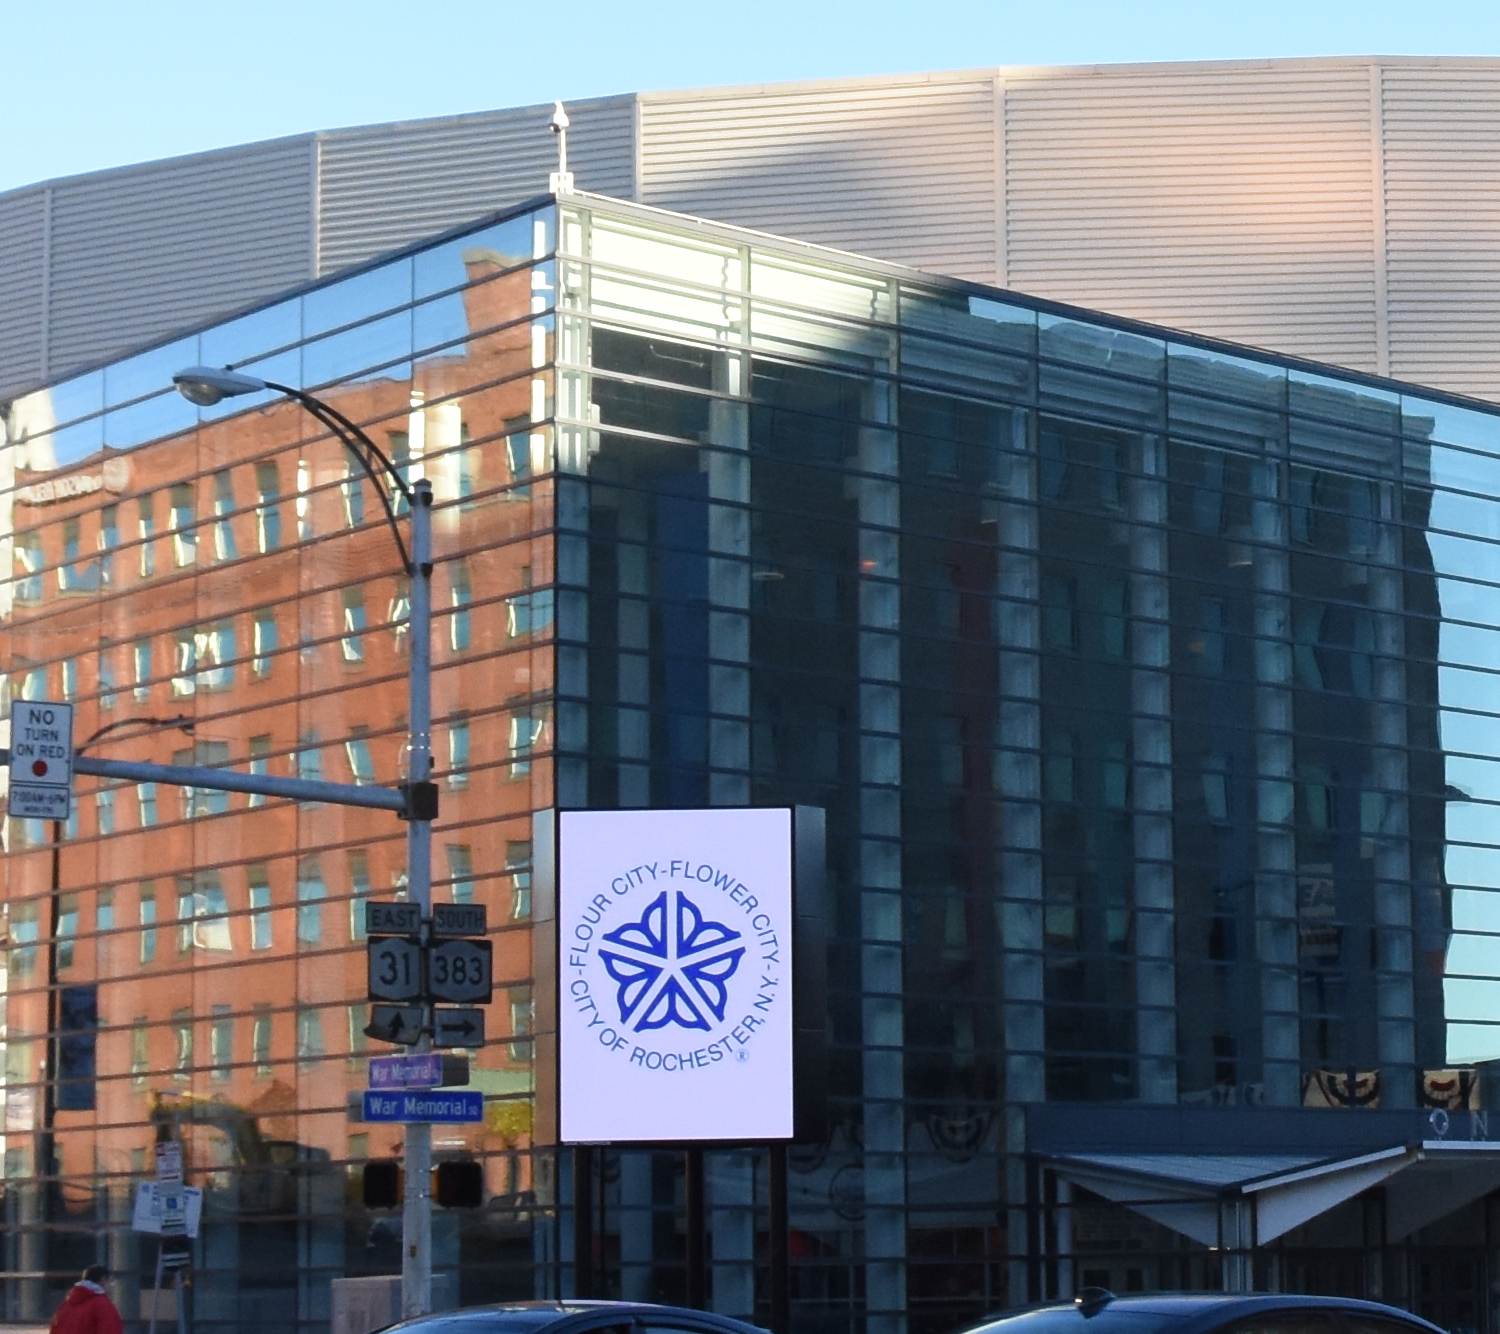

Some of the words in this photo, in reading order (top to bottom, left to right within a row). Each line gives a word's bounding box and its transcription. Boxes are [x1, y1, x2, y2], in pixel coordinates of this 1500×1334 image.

[28, 709, 55, 725] NO
[24, 727, 59, 741] TURN
[16, 744, 34, 756] ON
[39, 746, 66, 758] RED
[370, 908, 417, 927] EAST
[435, 909, 485, 929] SOUTH
[379, 951, 411, 985] 31
[434, 956, 484, 985] 383
[599, 1028, 629, 1052] OF
[371, 1064, 388, 1082] War
[369, 1097, 398, 1115] War
[404, 1097, 466, 1115] Memorial
